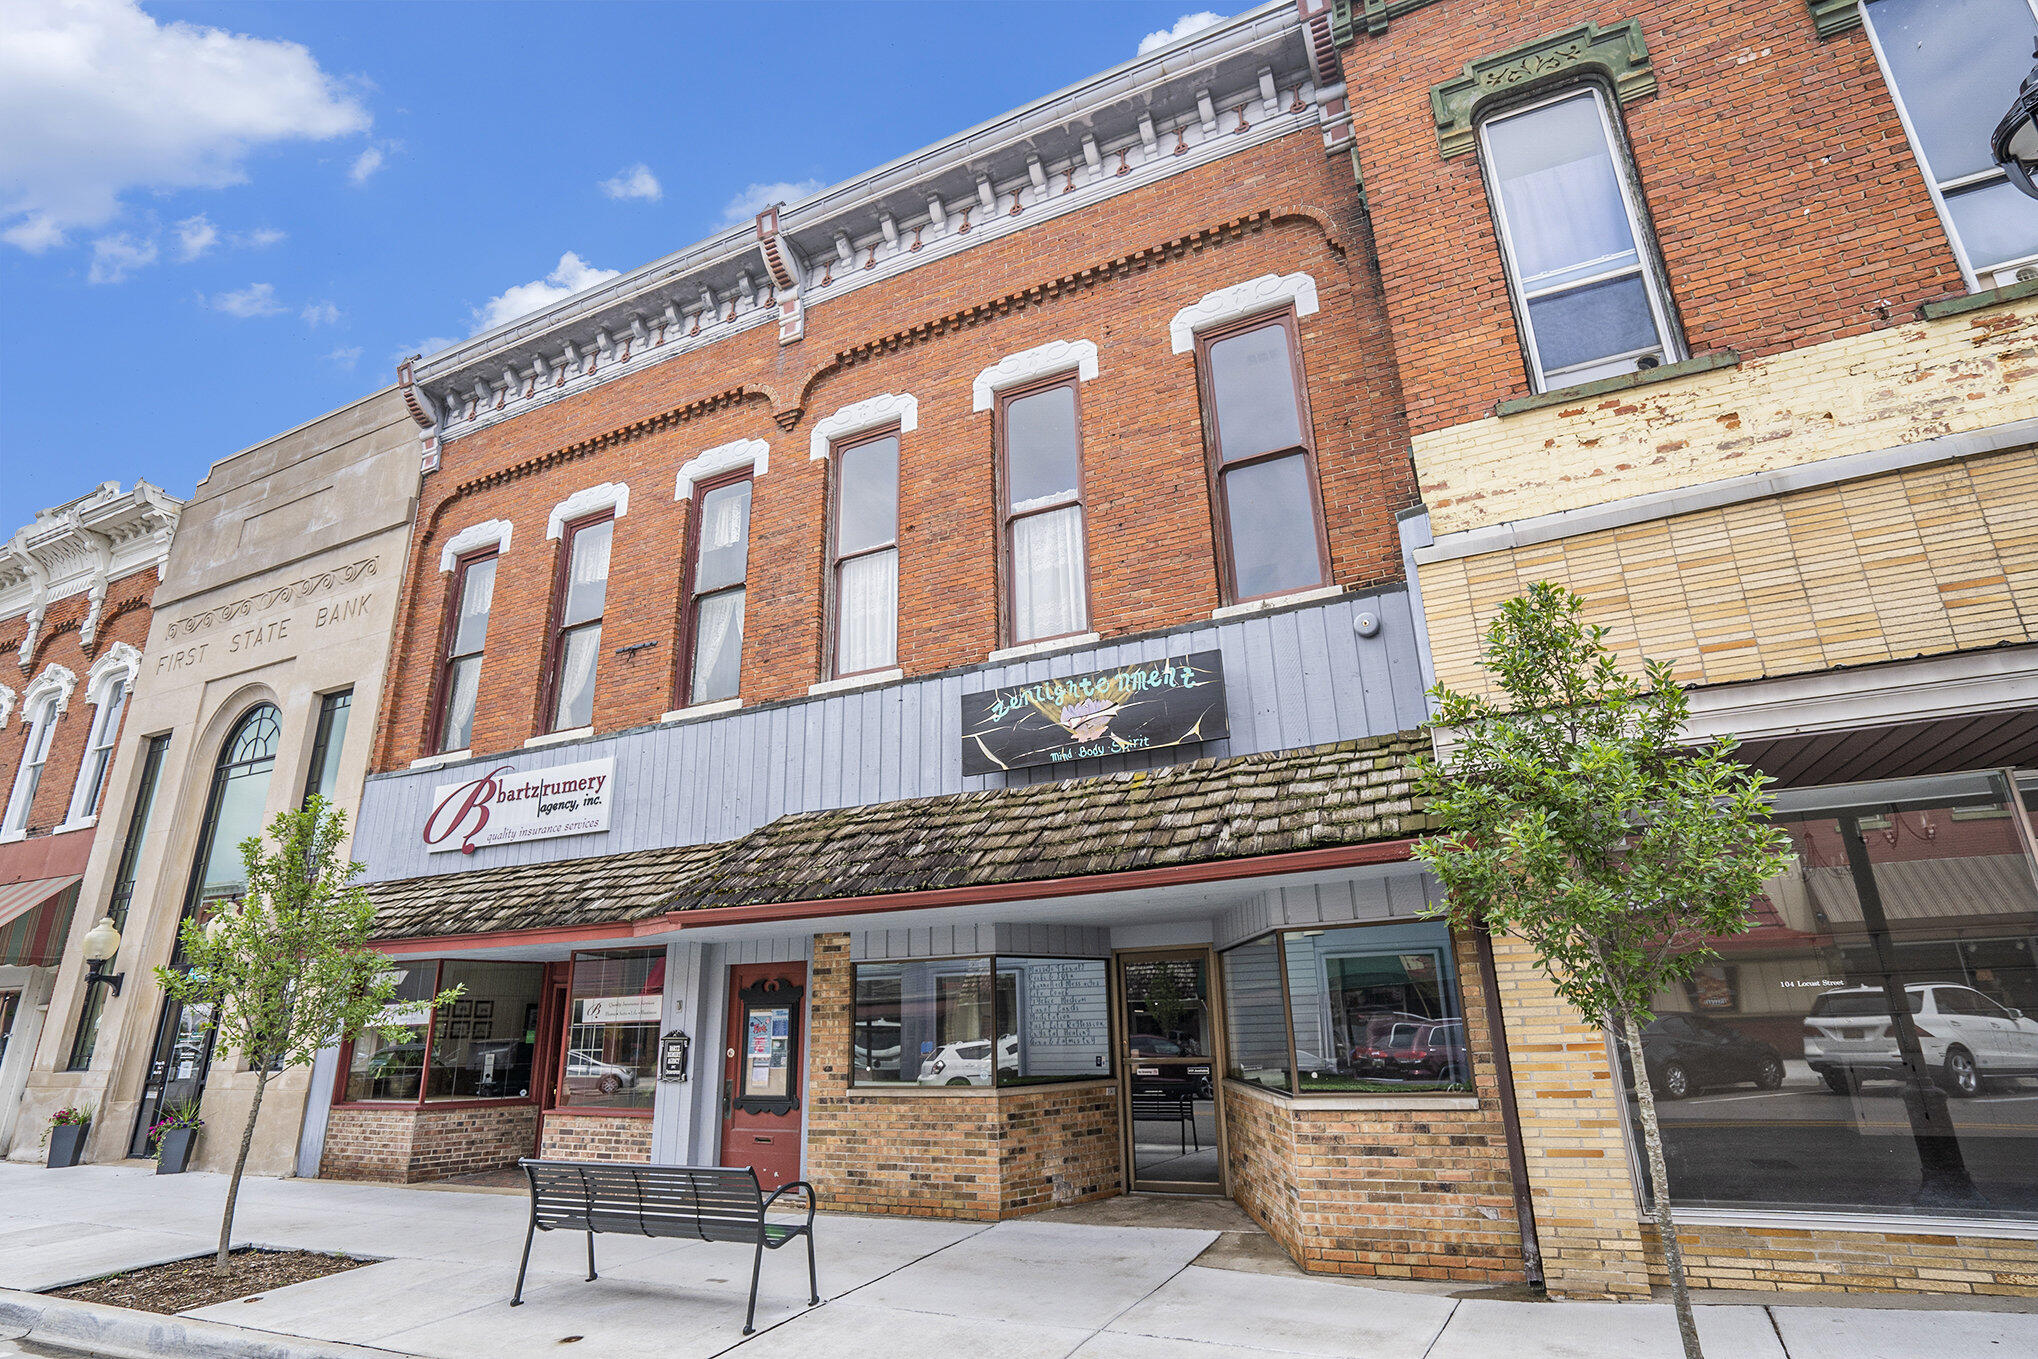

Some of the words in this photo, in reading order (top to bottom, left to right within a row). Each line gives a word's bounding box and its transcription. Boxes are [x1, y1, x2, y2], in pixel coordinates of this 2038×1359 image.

[156, 643, 209, 675] FIRST
[229, 618, 292, 653] STATE
[315, 593, 373, 628] BANK
[1079, 743, 1105, 759] Body
[1110, 735, 1150, 754] Spirit
[540, 799, 579, 815] agency,
[583, 793, 602, 807] inc.
[486, 827, 517, 843] quality
[518, 822, 562, 837] insurance
[564, 818, 600, 832] services
